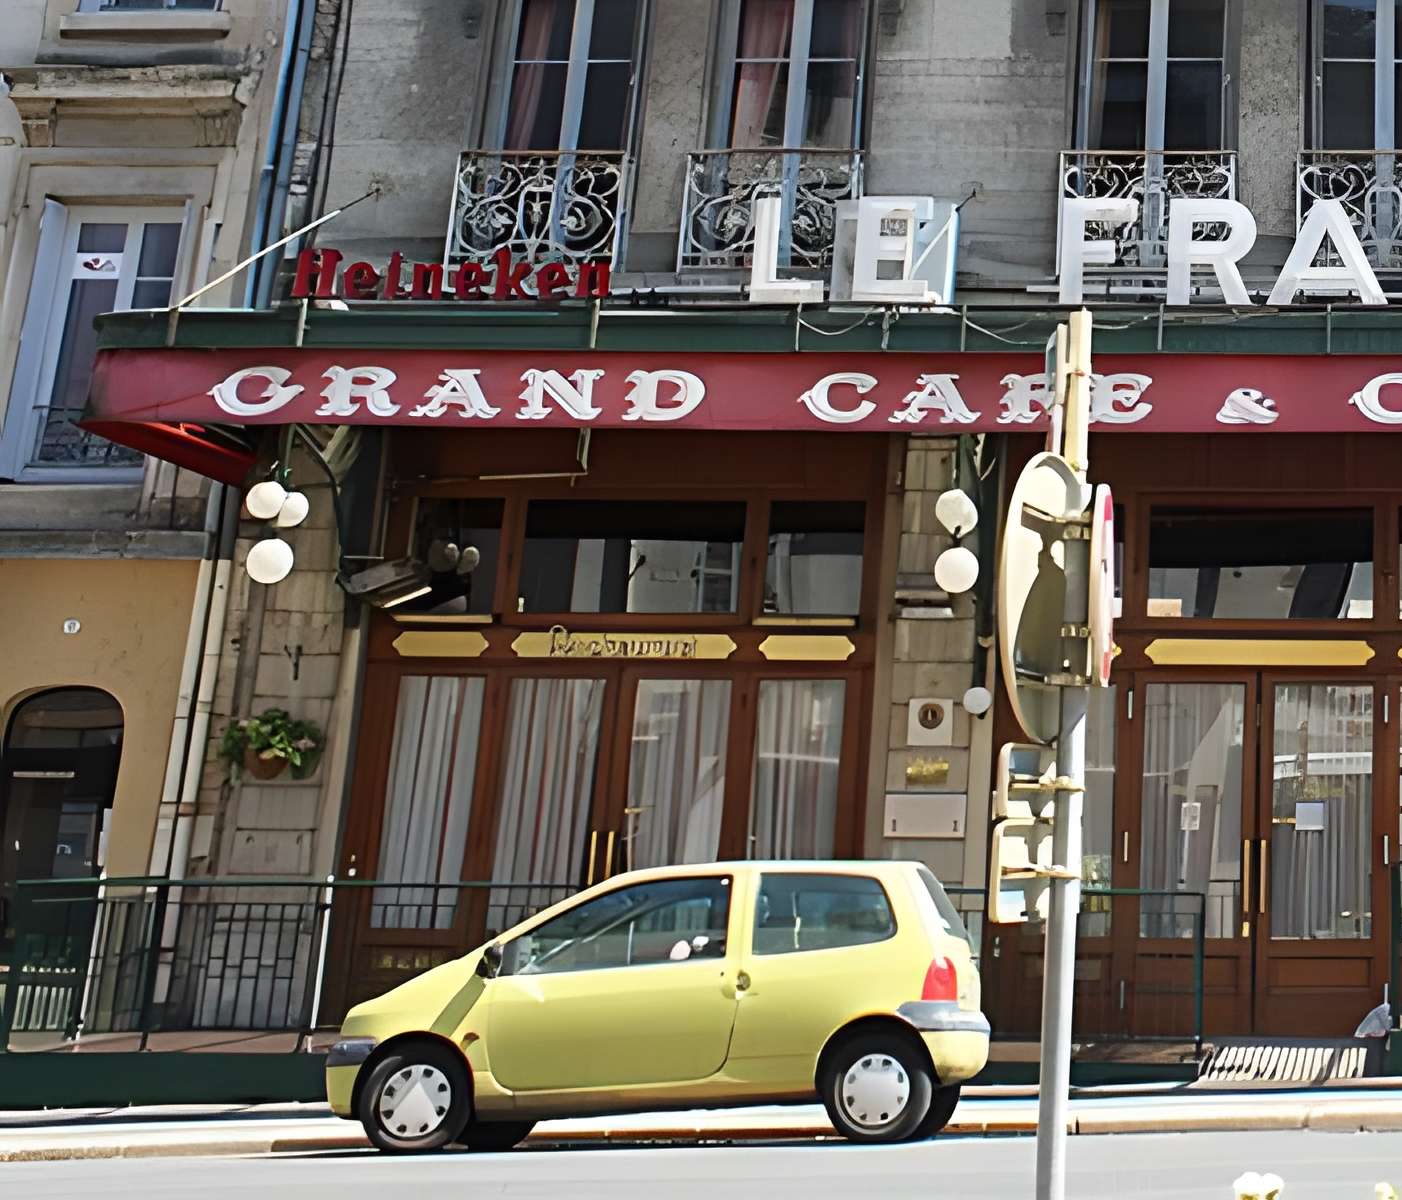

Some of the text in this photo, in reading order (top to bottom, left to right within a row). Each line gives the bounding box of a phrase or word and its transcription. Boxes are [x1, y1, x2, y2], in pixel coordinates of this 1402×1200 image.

[291, 246, 612, 300] Heineken
[748, 195, 936, 304] LE
[207, 364, 706, 423] GRAND
[799, 371, 1153, 425] CAFE
[1215, 387, 1280, 425] &
